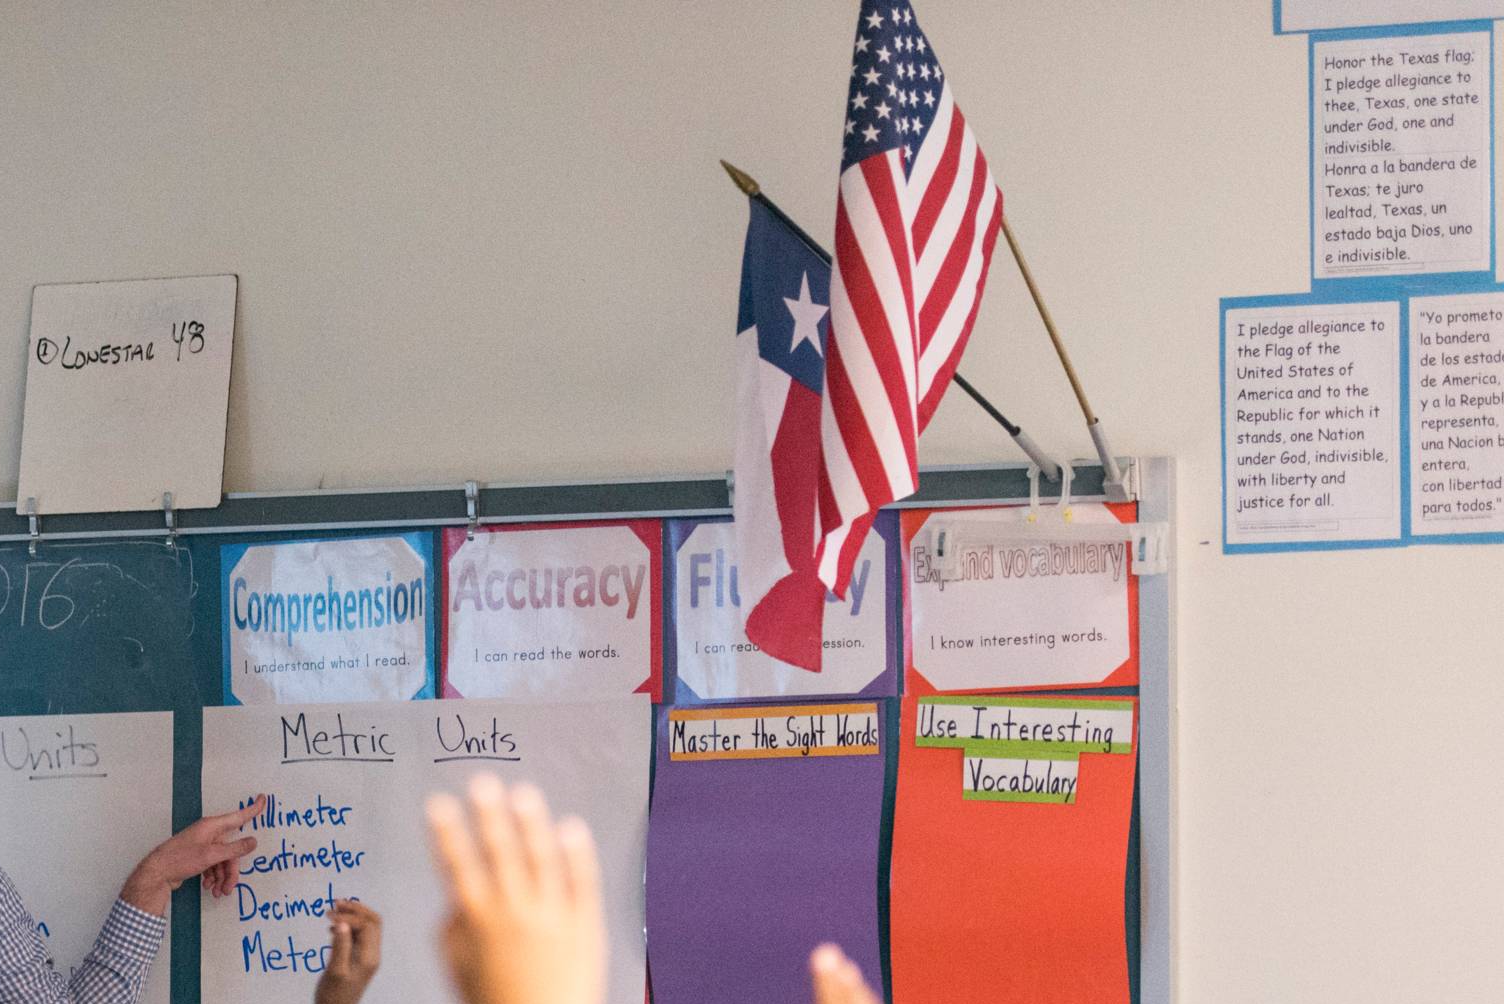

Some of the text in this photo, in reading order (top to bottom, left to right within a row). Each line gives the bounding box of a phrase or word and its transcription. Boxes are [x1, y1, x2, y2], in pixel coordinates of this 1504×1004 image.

[1325, 57, 1365, 69] Honor
[1371, 54, 1393, 66] the
[1400, 53, 1439, 65] Texas
[1325, 72, 1471, 94] I pledge allegiance to
[1325, 93, 1479, 112] thee, Texas, one state
[1324, 114, 1454, 133] under God, one and
[1325, 139, 1395, 154] indivisible.
[1325, 156, 1476, 176] Honra a la bandera de
[1376, 184, 1391, 195] te
[1395, 184, 1423, 198] juro
[1326, 204, 1446, 219] lealtad, Texas, un
[1325, 224, 1472, 242] estado baja Dios, uno
[1325, 247, 1410, 263] e indivisible.
[1447, 310, 1502, 326] prometo
[1238, 320, 1384, 339] I pledge allegiance to
[1421, 331, 1489, 345] la bandera
[172, 321, 204, 361] 48
[1238, 342, 1340, 360] the Flag of the
[1420, 354, 1436, 366] de
[1442, 353, 1459, 365] los
[1237, 362, 1353, 379] United States of
[1421, 375, 1500, 387] de America,
[1237, 384, 1368, 400] America and to the
[1421, 400, 1428, 411] y
[1433, 399, 1440, 408] a
[1445, 394, 1455, 407] la
[1237, 406, 1380, 425] Republic for which it
[1422, 415, 1498, 432] representa,
[1237, 428, 1364, 444] stands, one Nation
[1422, 441, 1444, 450] una
[1448, 437, 1493, 448] Nacion
[1238, 448, 1388, 465] under God, indivisible,
[1422, 460, 1469, 471] entera,
[1238, 471, 1345, 488] with liberty and
[1422, 476, 1502, 492] con libertad
[1237, 496, 1284, 513] justice
[1289, 494, 1310, 508] for
[1423, 504, 1451, 517] para
[452, 559, 646, 619] Accuracy
[232, 571, 423, 646] Comprehension
[941, 628, 1106, 649] know interesting words.
[485, 644, 619, 662] can read the words.
[704, 644, 726, 653] can
[253, 652, 410, 676] understand what read.
[281, 713, 516, 758] Metric Units
[672, 717, 879, 755] Master the Sight Words
[919, 707, 1113, 753] Use Interesting
[2, 725, 100, 772] Units
[969, 759, 1077, 801] Vocabulary
[239, 838, 365, 874] entimeter
[235, 882, 360, 921] Decimet
[242, 930, 333, 972] Meter
